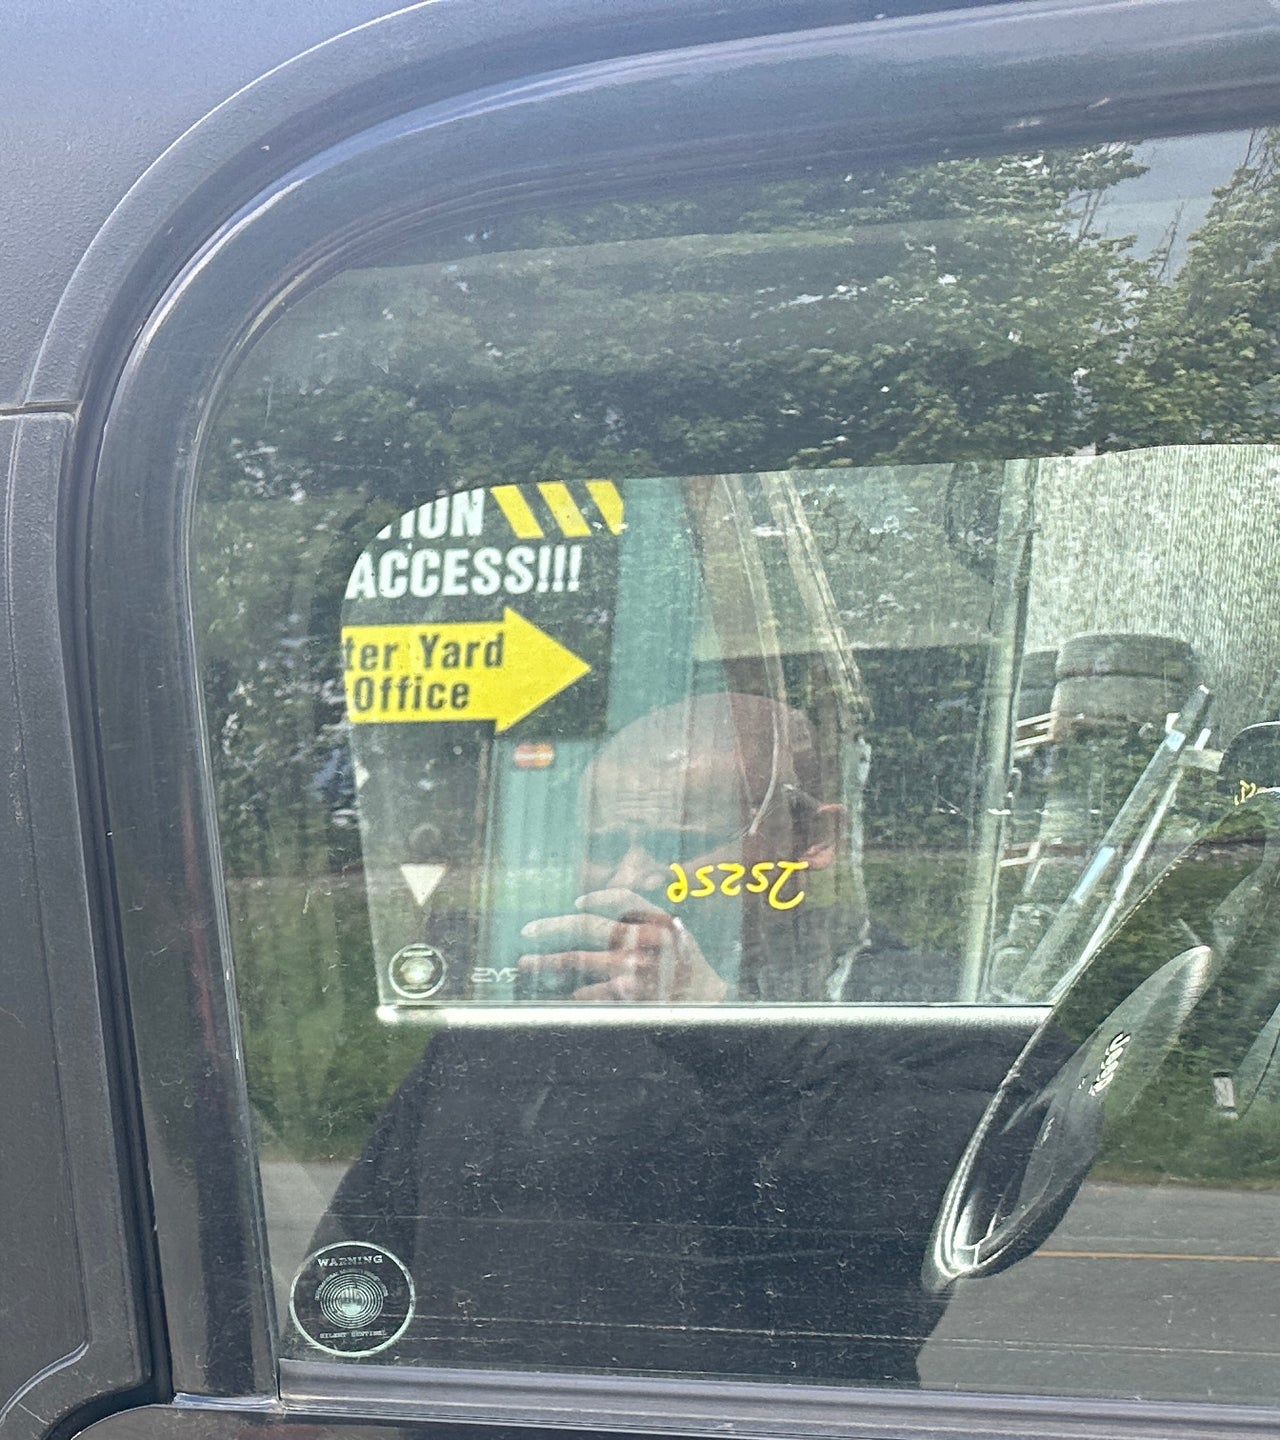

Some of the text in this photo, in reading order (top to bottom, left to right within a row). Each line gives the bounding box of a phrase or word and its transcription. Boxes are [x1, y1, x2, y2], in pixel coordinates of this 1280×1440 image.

[376, 487, 487, 541] ION
[343, 544, 584, 600] ACCESS!!!
[418, 631, 507, 669] Yard
[351, 675, 472, 712] Office
[316, 1254, 384, 1268] WARNING
